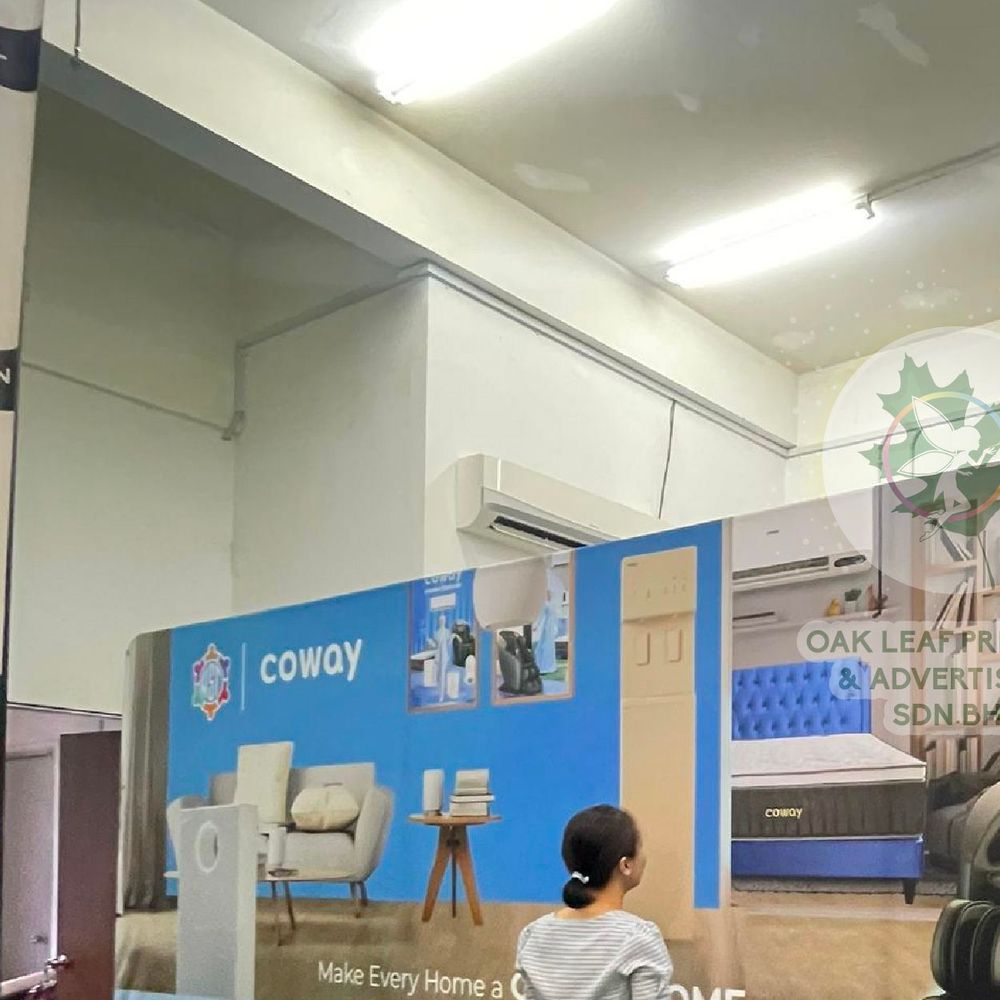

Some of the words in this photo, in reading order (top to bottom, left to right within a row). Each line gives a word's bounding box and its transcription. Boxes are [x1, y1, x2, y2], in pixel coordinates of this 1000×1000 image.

[260, 639, 363, 684] coway
[765, 808, 803, 819] coway
[318, 961, 365, 986] Make
[369, 965, 420, 997] Every
[424, 968, 486, 998] Home
[490, 979, 503, 999] a
